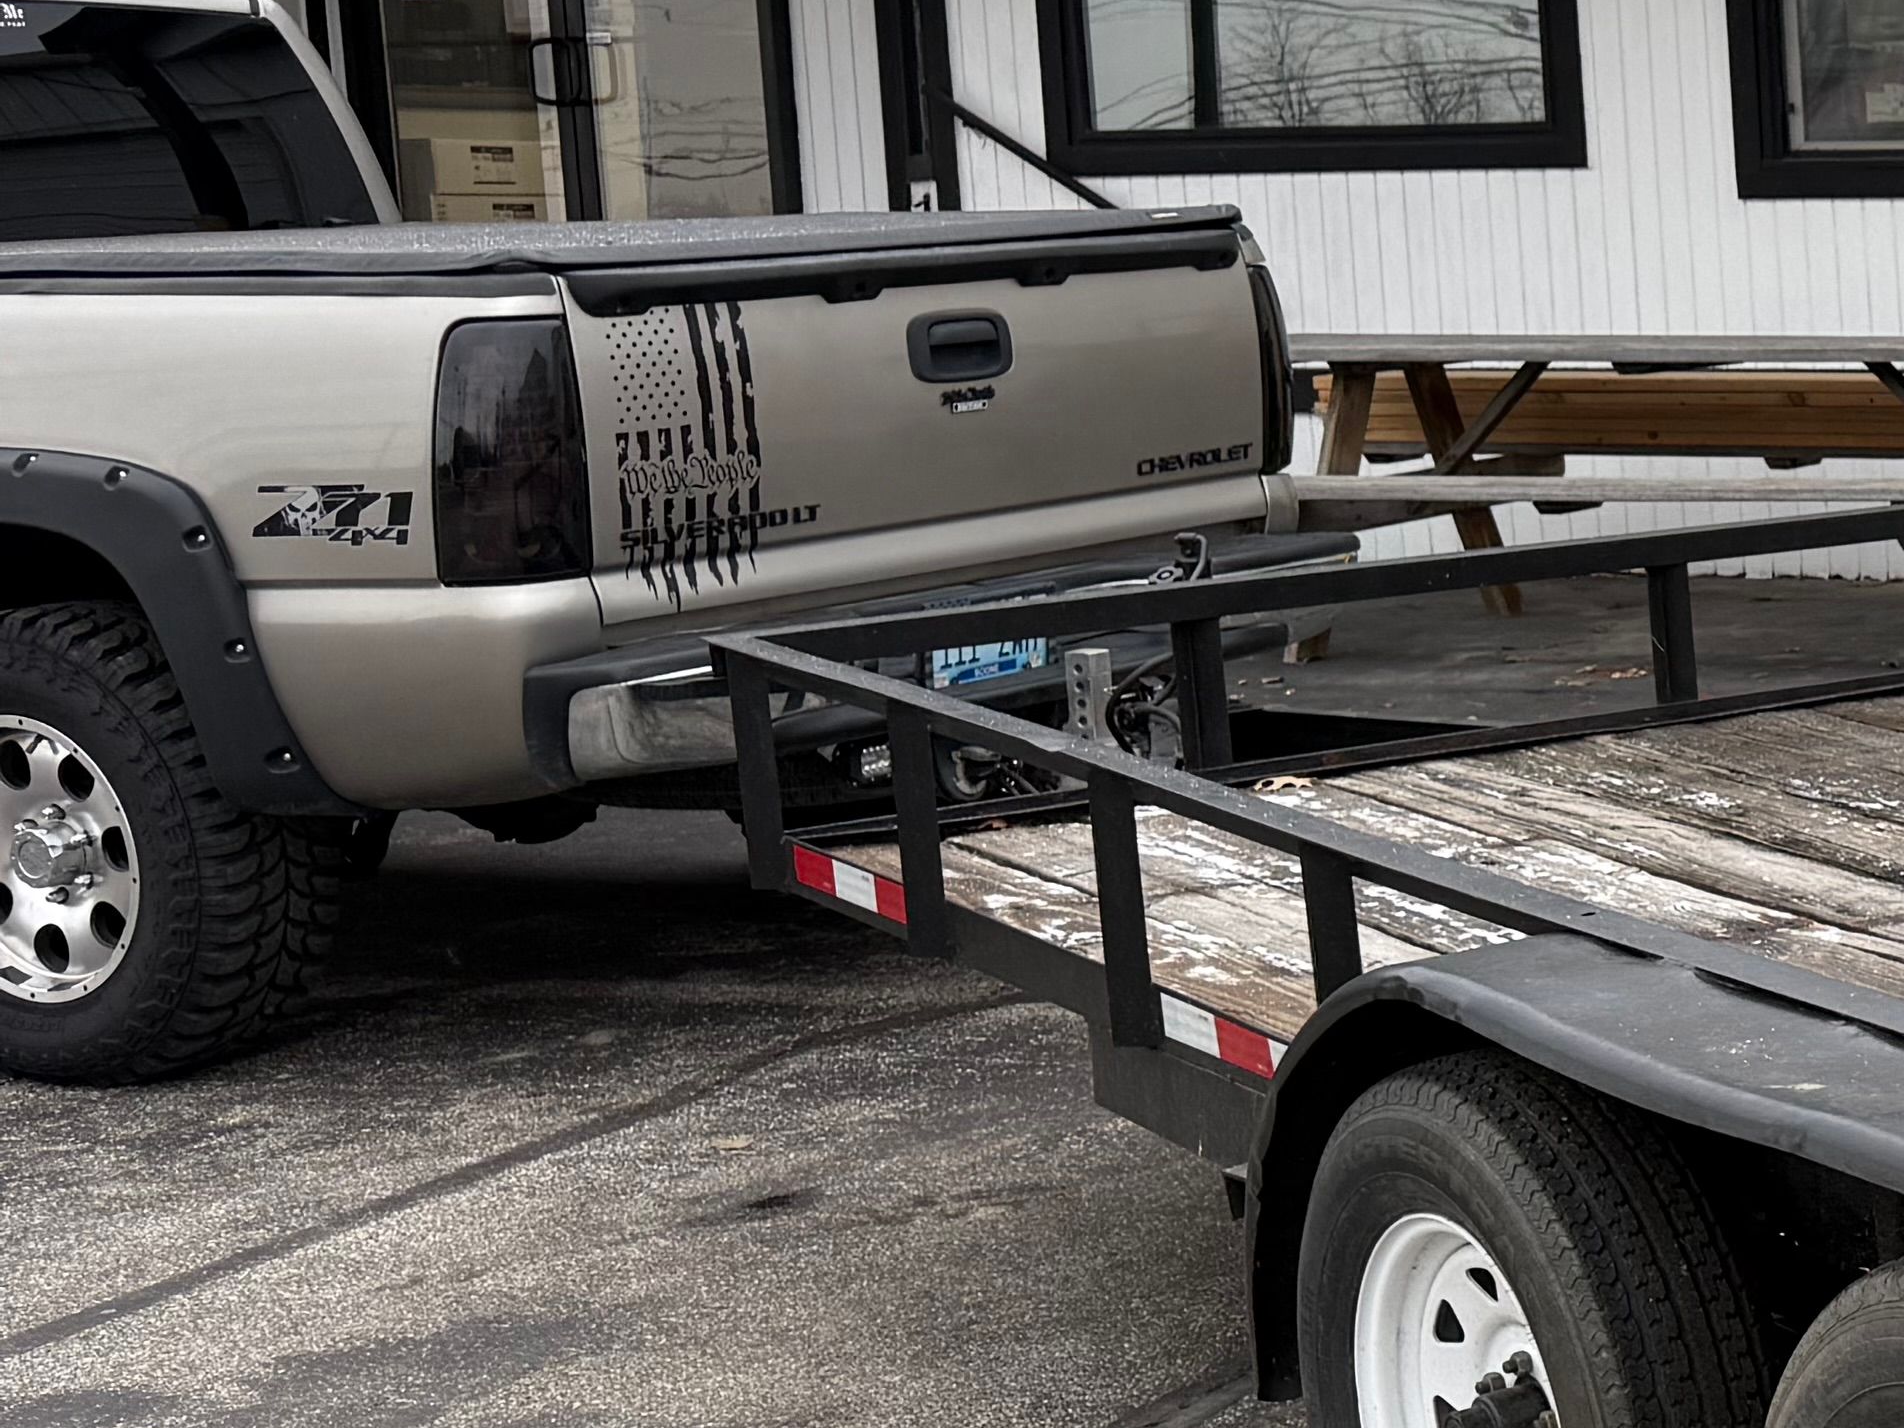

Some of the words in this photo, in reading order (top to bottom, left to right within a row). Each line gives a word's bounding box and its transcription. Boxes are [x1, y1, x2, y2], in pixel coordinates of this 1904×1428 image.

[621, 463, 662, 499] We
[661, 457, 690, 495] the
[686, 449, 760, 492] People
[1136, 441, 1253, 476] CHEVROLET
[252, 483, 414, 538] Z71
[619, 508, 789, 548] SILVERADO
[792, 503, 821, 525] LT
[328, 525, 410, 547] 4x4
